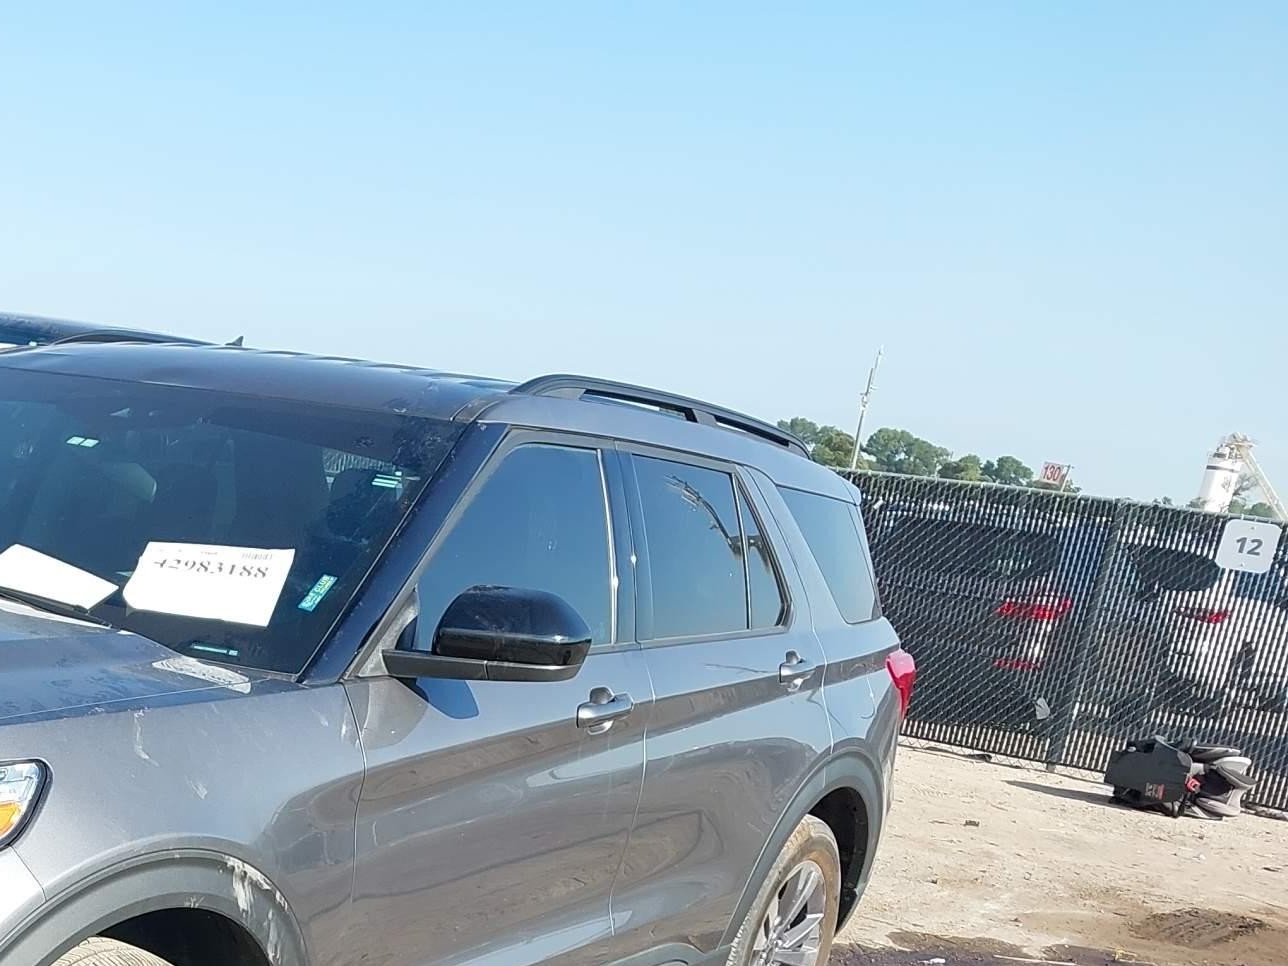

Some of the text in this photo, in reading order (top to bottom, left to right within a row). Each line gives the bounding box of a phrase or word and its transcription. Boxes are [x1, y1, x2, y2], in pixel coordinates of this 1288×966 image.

[1043, 463, 1062, 481] 130
[1236, 536, 1263, 556] 12
[153, 558, 269, 578] 42983188
